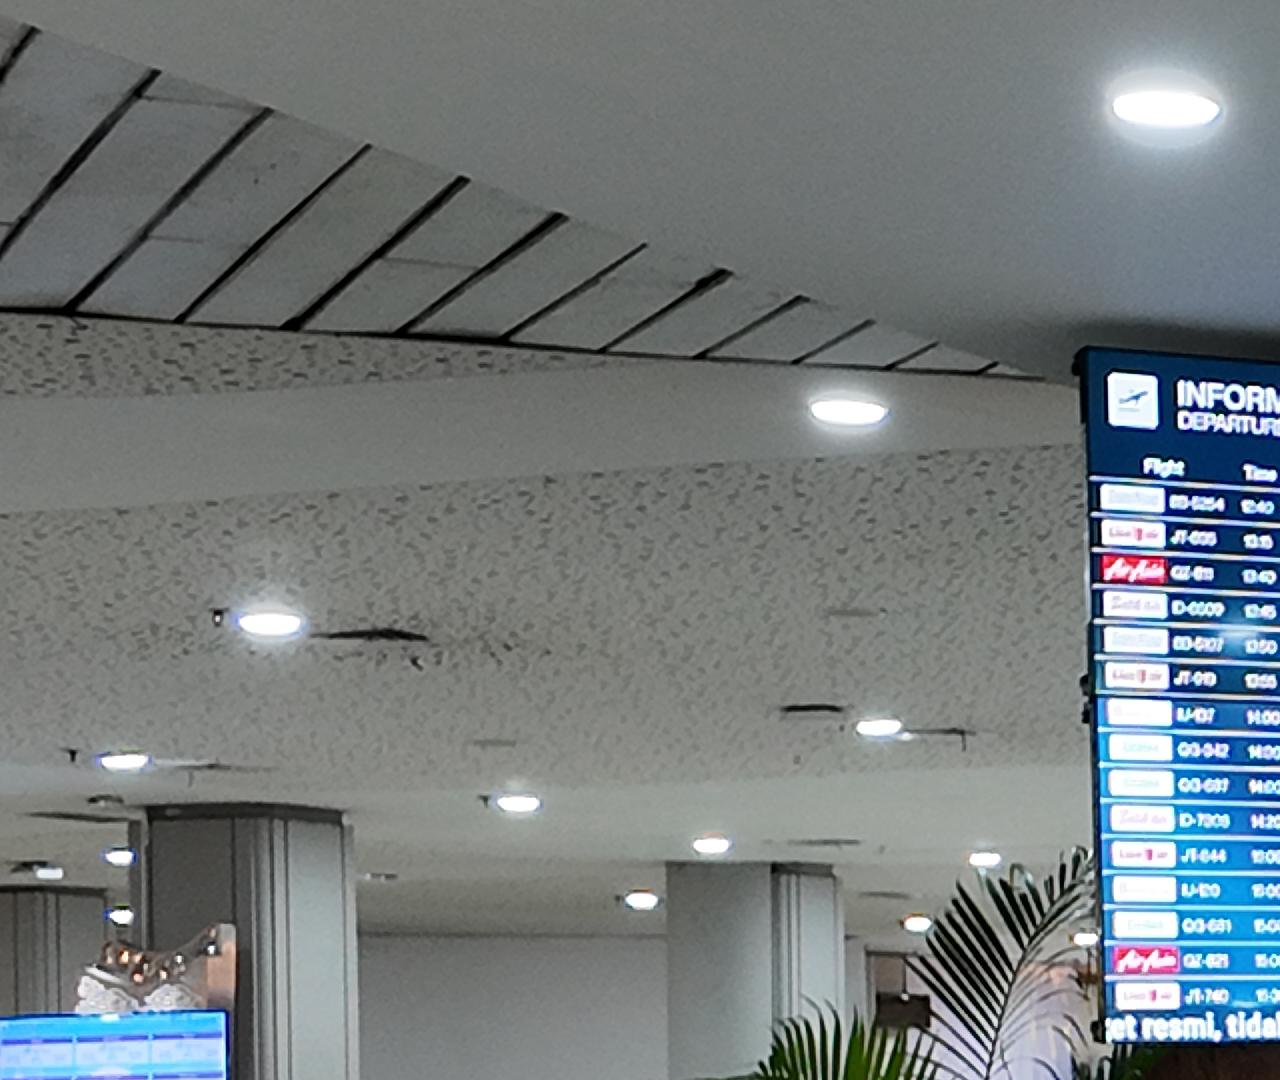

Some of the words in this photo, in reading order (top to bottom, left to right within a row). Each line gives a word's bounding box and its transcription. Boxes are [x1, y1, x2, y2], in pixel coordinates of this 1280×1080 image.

[1143, 458, 1184, 478] Flight
[1243, 464, 1277, 482] Time
[1140, 1008, 1222, 1042] resmi,
